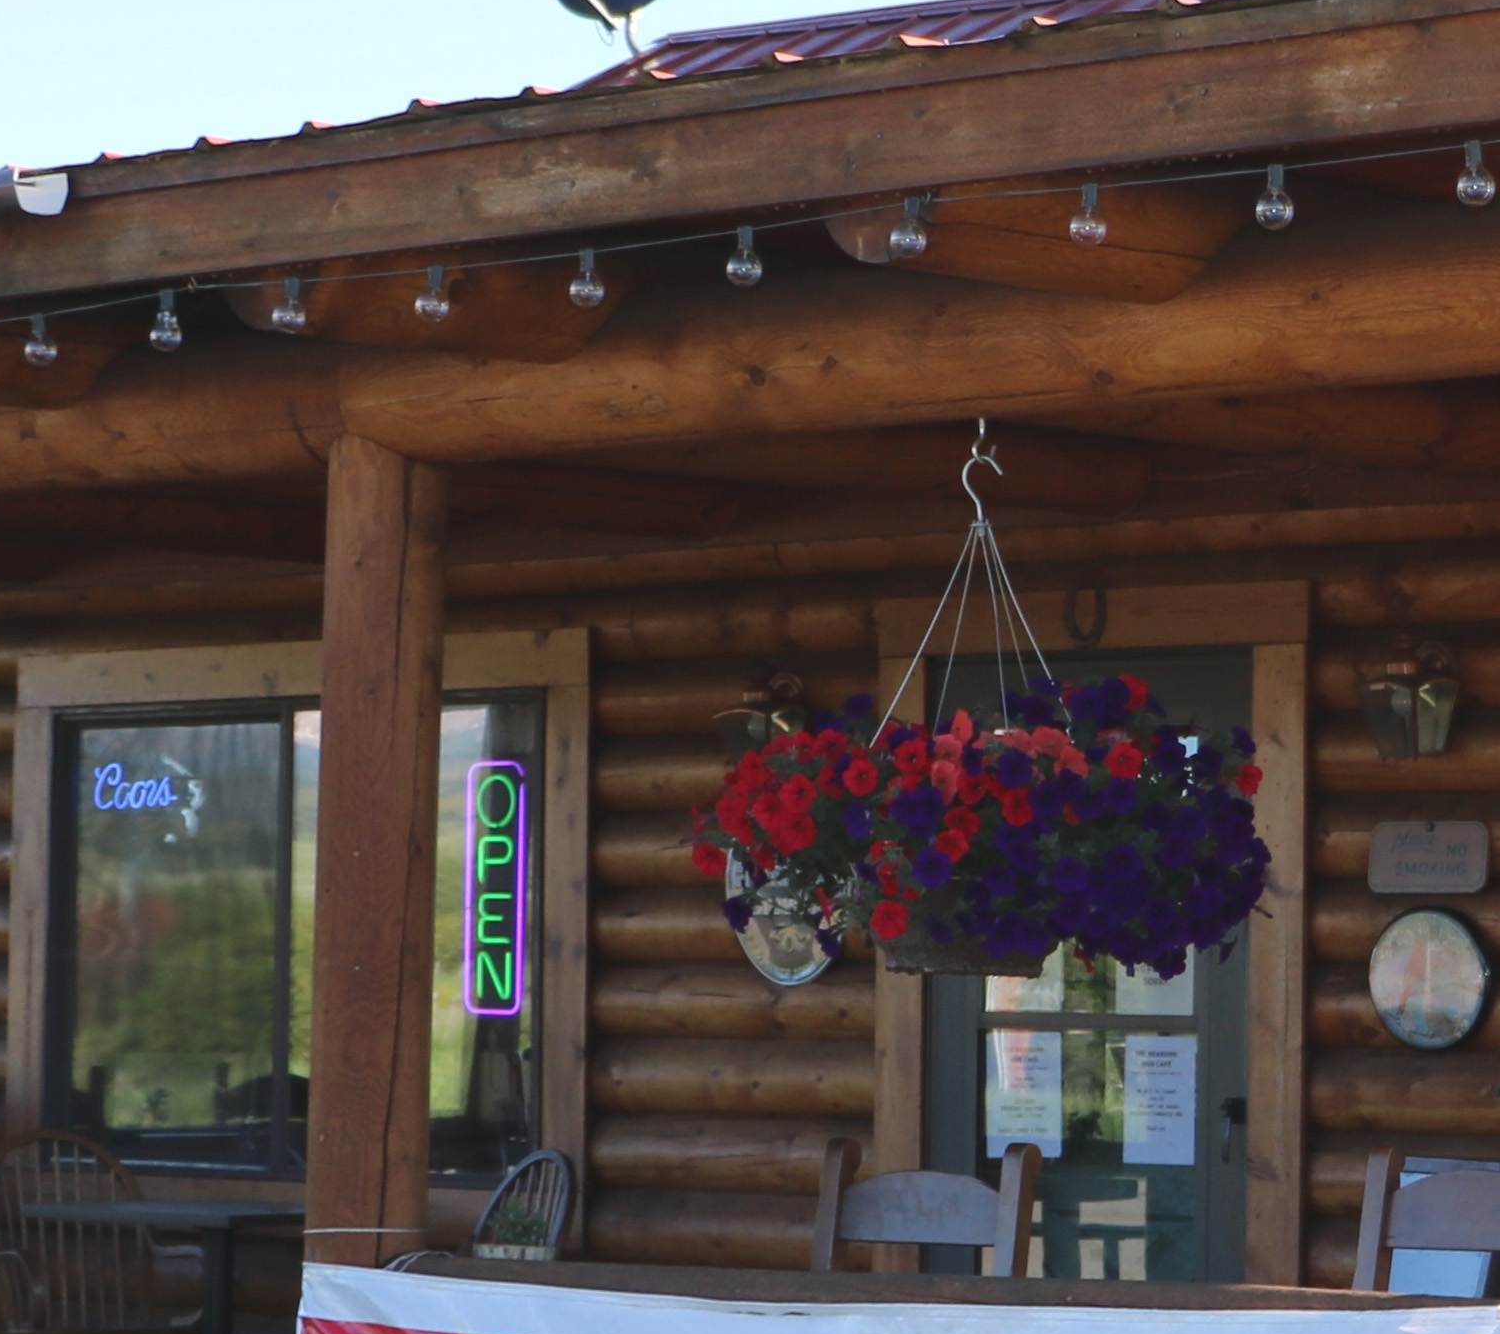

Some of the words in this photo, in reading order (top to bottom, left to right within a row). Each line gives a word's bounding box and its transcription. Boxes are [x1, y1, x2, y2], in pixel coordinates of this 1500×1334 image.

[93, 761, 180, 811] Coors
[1446, 843, 1469, 858] NO
[1394, 860, 1469, 877] SMOKING
[476, 773, 518, 1002] OPEN
